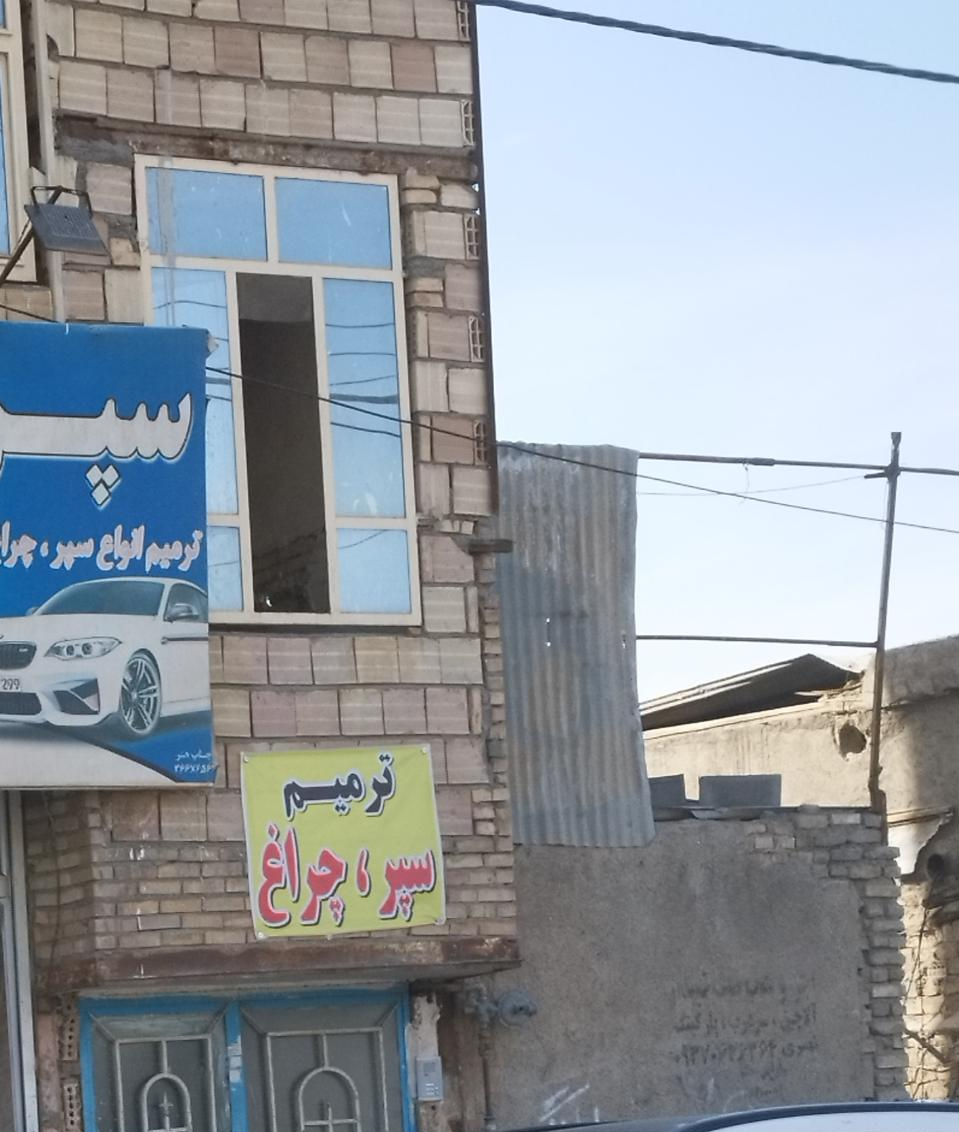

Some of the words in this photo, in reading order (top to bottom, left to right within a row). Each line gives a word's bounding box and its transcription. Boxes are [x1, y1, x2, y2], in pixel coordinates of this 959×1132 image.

[96, 525, 145, 571] انواع
[146, 530, 203, 572] ترمیم
[283, 752, 395, 821] ترمیم
[257, 824, 347, 927] چراغ
